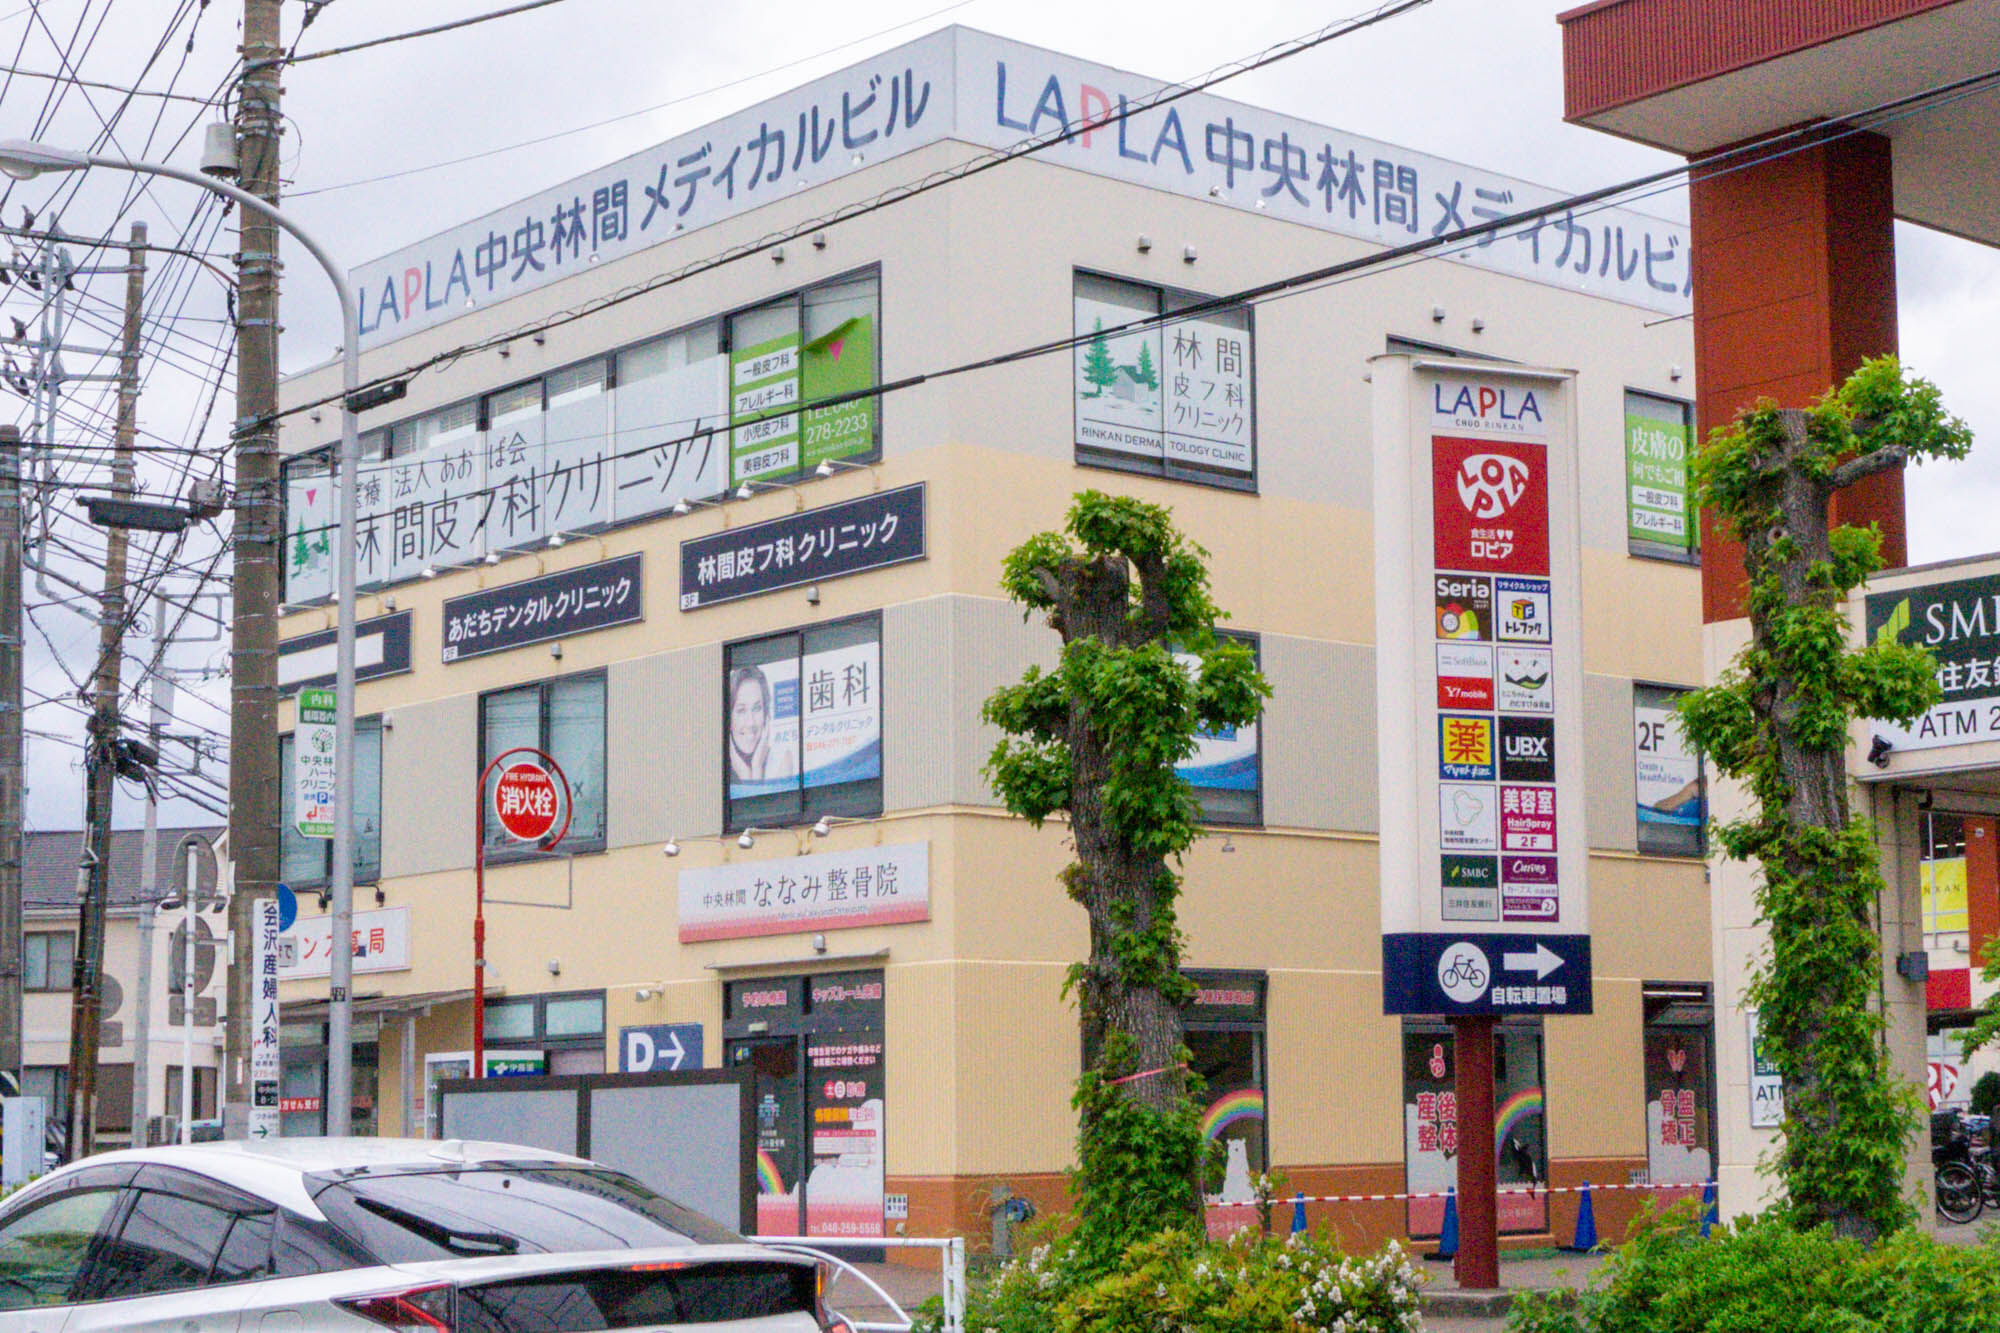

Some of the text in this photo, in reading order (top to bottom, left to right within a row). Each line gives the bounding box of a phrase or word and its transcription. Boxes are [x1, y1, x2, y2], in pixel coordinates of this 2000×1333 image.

[996, 60, 1194, 175] LAPLA
[1204, 116, 1419, 235] 中央林間
[358, 67, 931, 335] LAPLA 中央林間 メディカルビル
[743, 353, 790, 377] 一般皮フ科
[1173, 328, 1242, 378] 林間
[739, 383, 794, 411] アレルギー科
[1174, 372, 1243, 408] 皮フ科
[1435, 383, 1542, 422] LAPLA
[1174, 402, 1243, 435] クリニック
[1455, 418, 1524, 431] CHUO RINKAN
[1081, 427, 1123, 443] RINKAN
[1212, 449, 1246, 462] CLINIC
[1631, 426, 1684, 461] 皮膚の
[1634, 512, 1682, 530] アレルギー科
[698, 513, 899, 586] 林間皮フ科クリニック
[1471, 541, 1514, 559] ロピア
[1437, 578, 1489, 598] Seria
[1497, 581, 1549, 592] リサイクルショップ
[447, 576, 631, 642] あだちデンタルクリニック
[1505, 621, 1542, 635] トレファク
[312, 694, 334, 706] 内科
[808, 661, 871, 714] 歯科
[1638, 721, 1665, 752] 2F
[1920, 708, 1977, 739] ATM
[1448, 719, 1485, 762] 薬
[1505, 735, 1548, 756] UBX
[301, 756, 334, 766] 中央林
[300, 780, 336, 791] クリニッ
[501, 785, 553, 817] 消火栓
[1503, 788, 1554, 815] 美容室
[1520, 836, 1538, 847] 2F
[703, 862, 898, 909] 中央林間 ななみ整骨院
[1461, 867, 1489, 878] SMBC
[1491, 986, 1567, 1005] 自転車置場
[627, 1032, 655, 1073] D
[1416, 1091, 1457, 1122] 産後
[1660, 1089, 1695, 1118] 骨盤
[1417, 1120, 1457, 1152] 整体
[1660, 1118, 1696, 1146] 矯正
